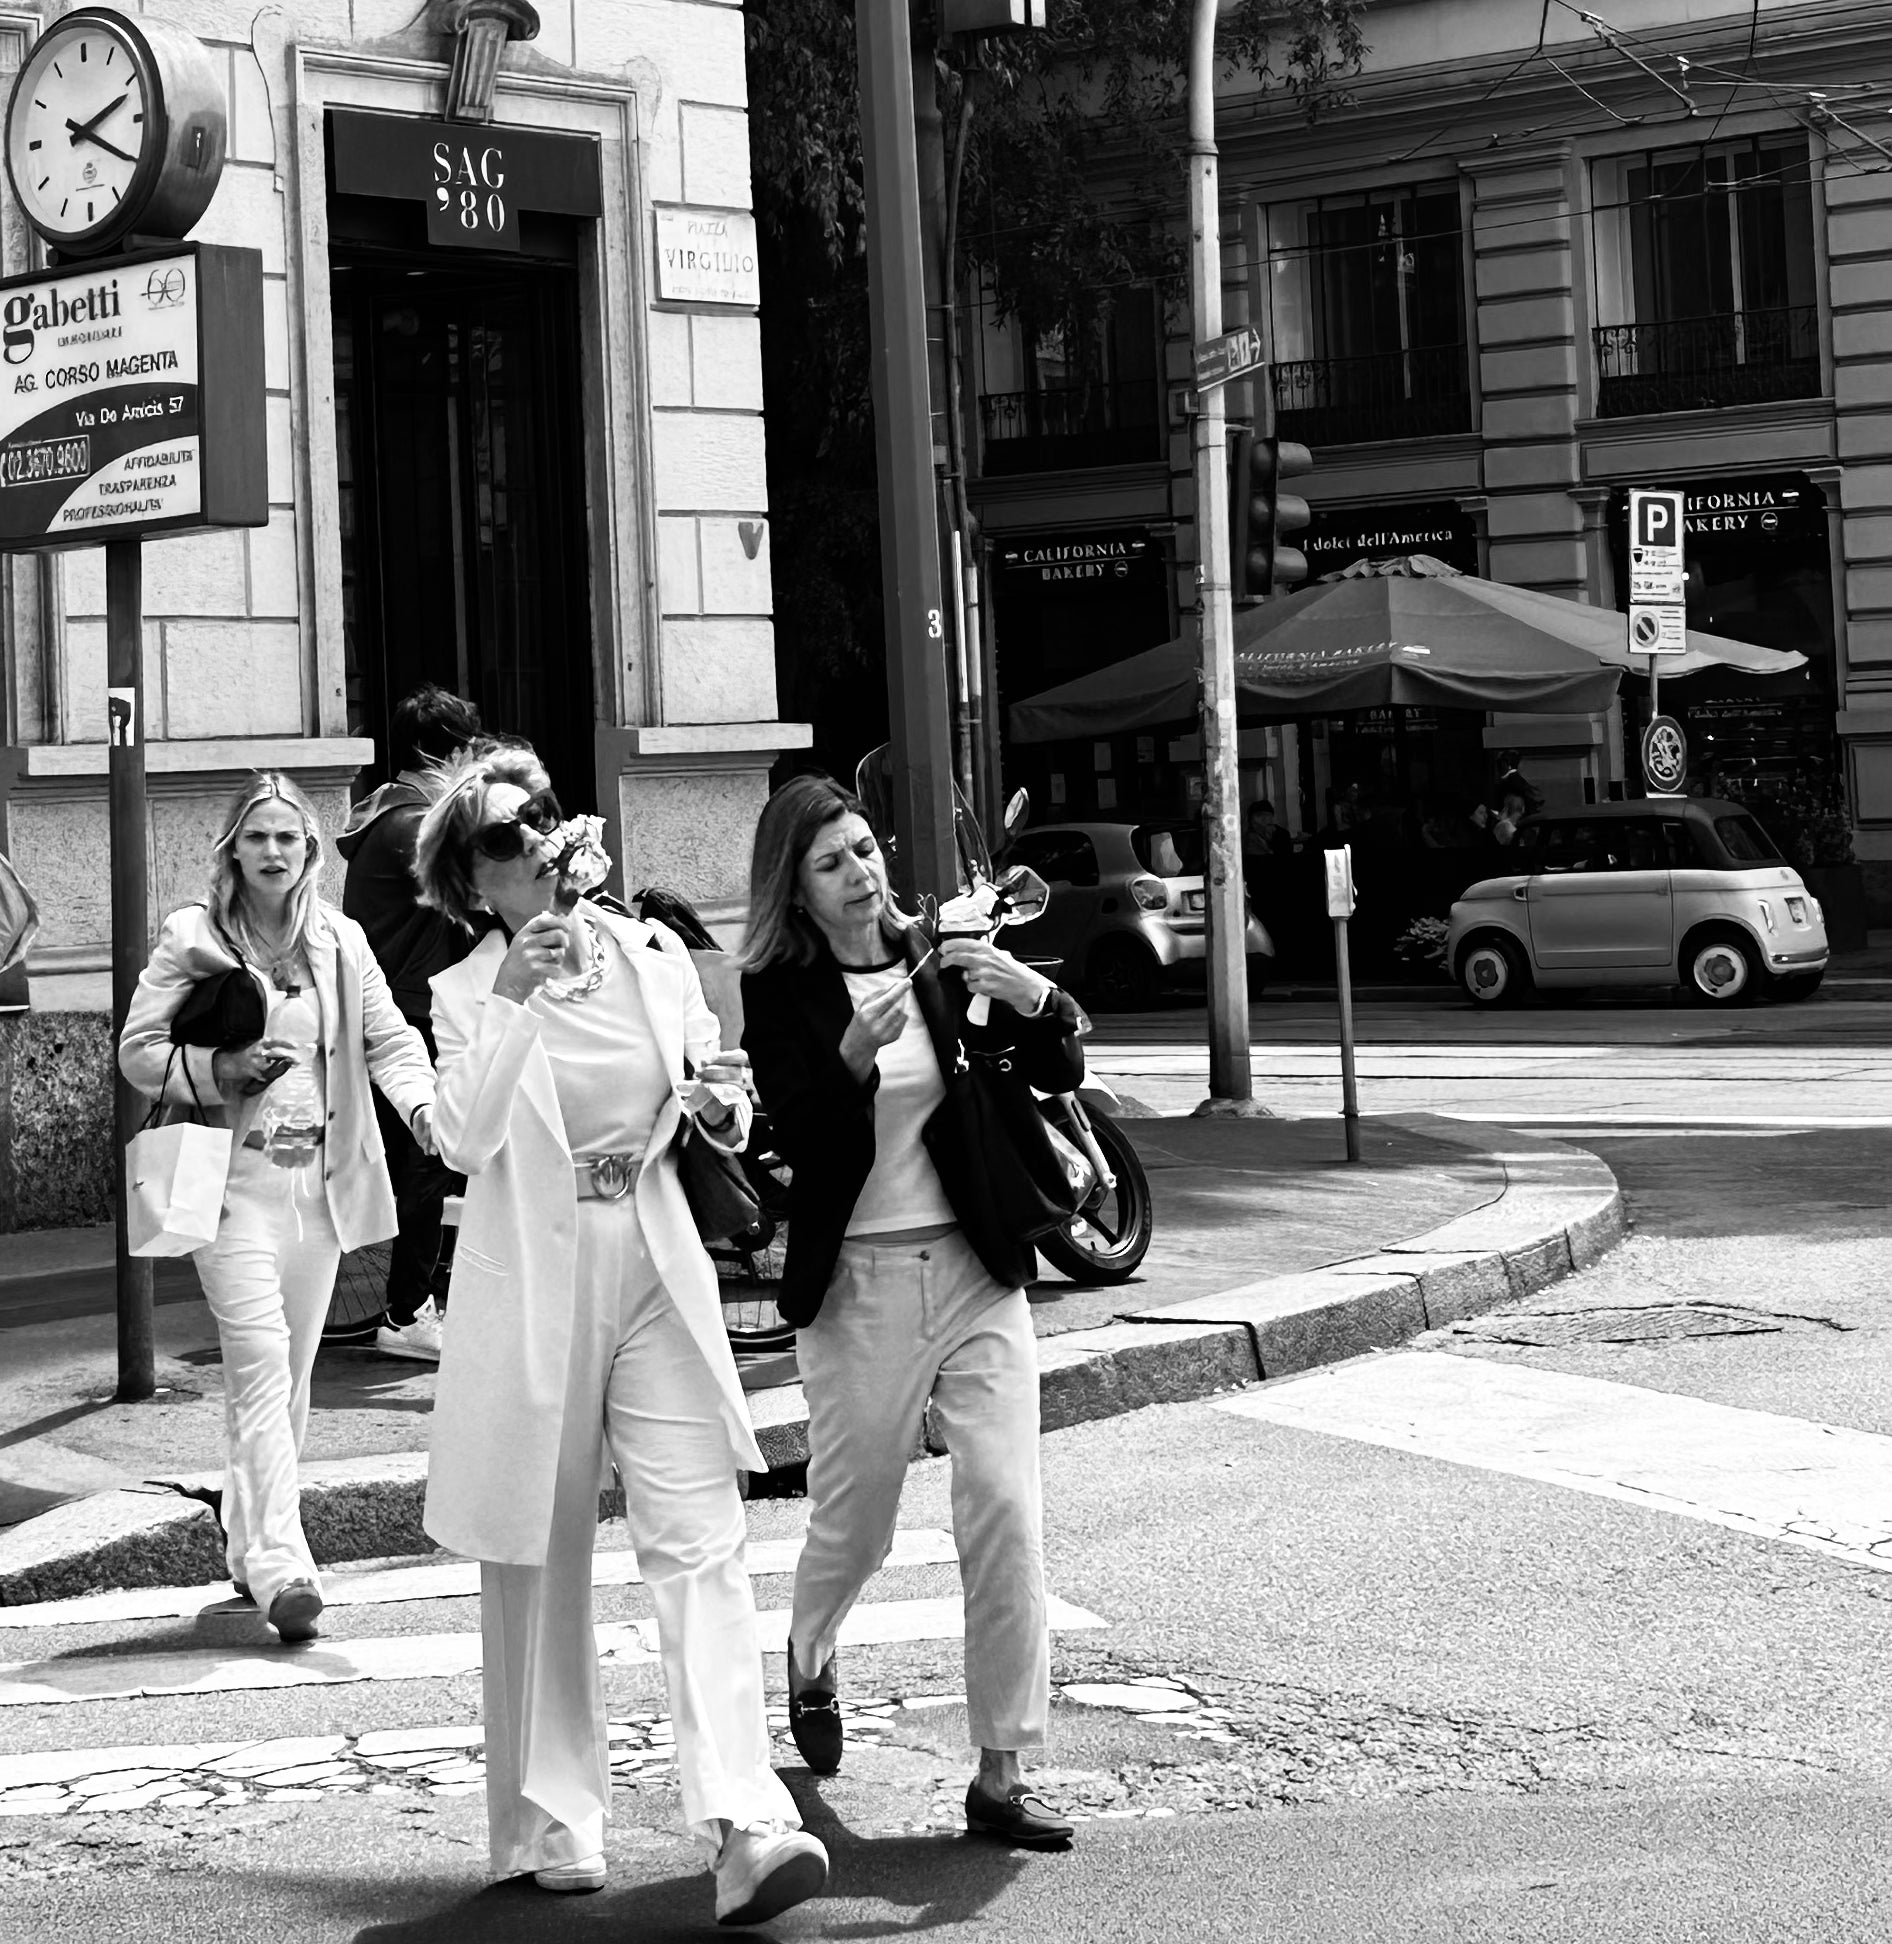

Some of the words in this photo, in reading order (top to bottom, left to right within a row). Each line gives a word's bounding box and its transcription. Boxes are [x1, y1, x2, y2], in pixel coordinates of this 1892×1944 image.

[432, 142, 505, 189] SAG
[664, 248, 754, 273] VIRGILIO
[3, 279, 122, 365] gabetti
[45, 362, 100, 389] CORSO
[106, 350, 179, 380] MAGENTA
[75, 411, 96, 428] Via
[169, 396, 184, 414] 57
[1647, 503, 1669, 542] P
[1024, 543, 1126, 562] CALIFORNIA
[1313, 537, 1351, 551] dolci
[1357, 530, 1453, 547] dell'America
[1042, 564, 1105, 580] BAKERY
[927, 608, 943, 638] 3
